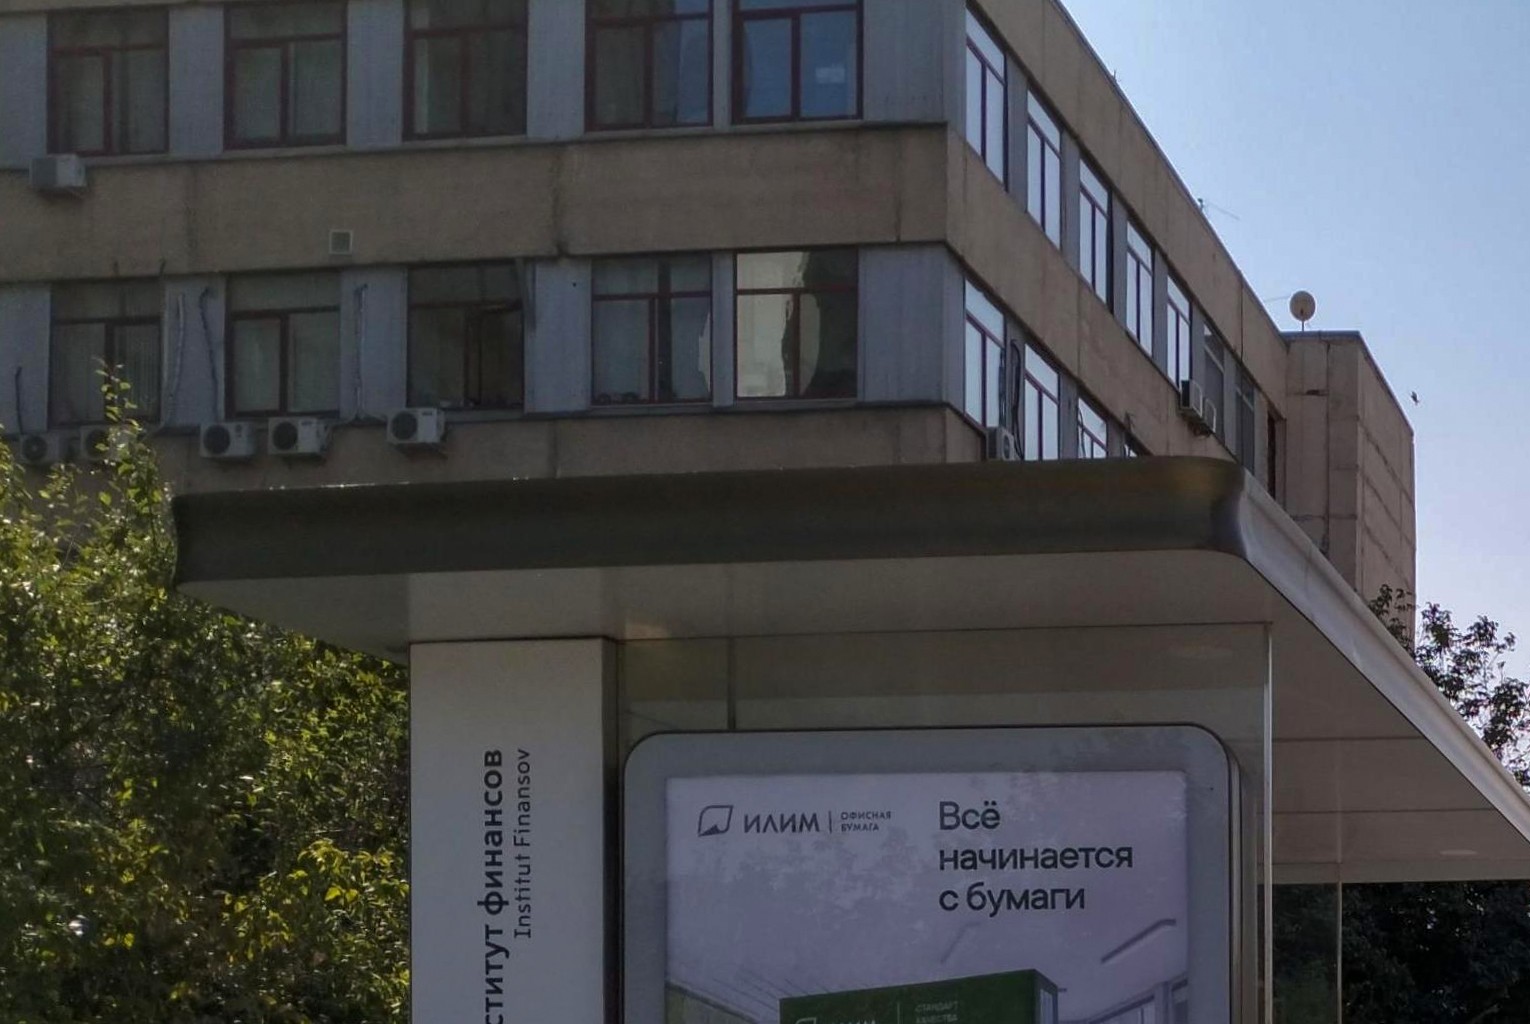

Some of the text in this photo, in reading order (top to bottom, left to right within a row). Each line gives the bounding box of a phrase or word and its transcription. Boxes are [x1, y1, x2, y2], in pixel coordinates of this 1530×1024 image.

[743, 813, 820, 835] ИЛИМ
[840, 811, 892, 821] ОФИСНАЯ
[840, 823, 880, 832] БУМАГА
[939, 800, 1001, 831] Всё
[477, 749, 509, 915] финансов
[513, 749, 532, 939] Institut Finansov
[939, 845, 1134, 871] начинается
[939, 881, 1086, 918] с бумаги
